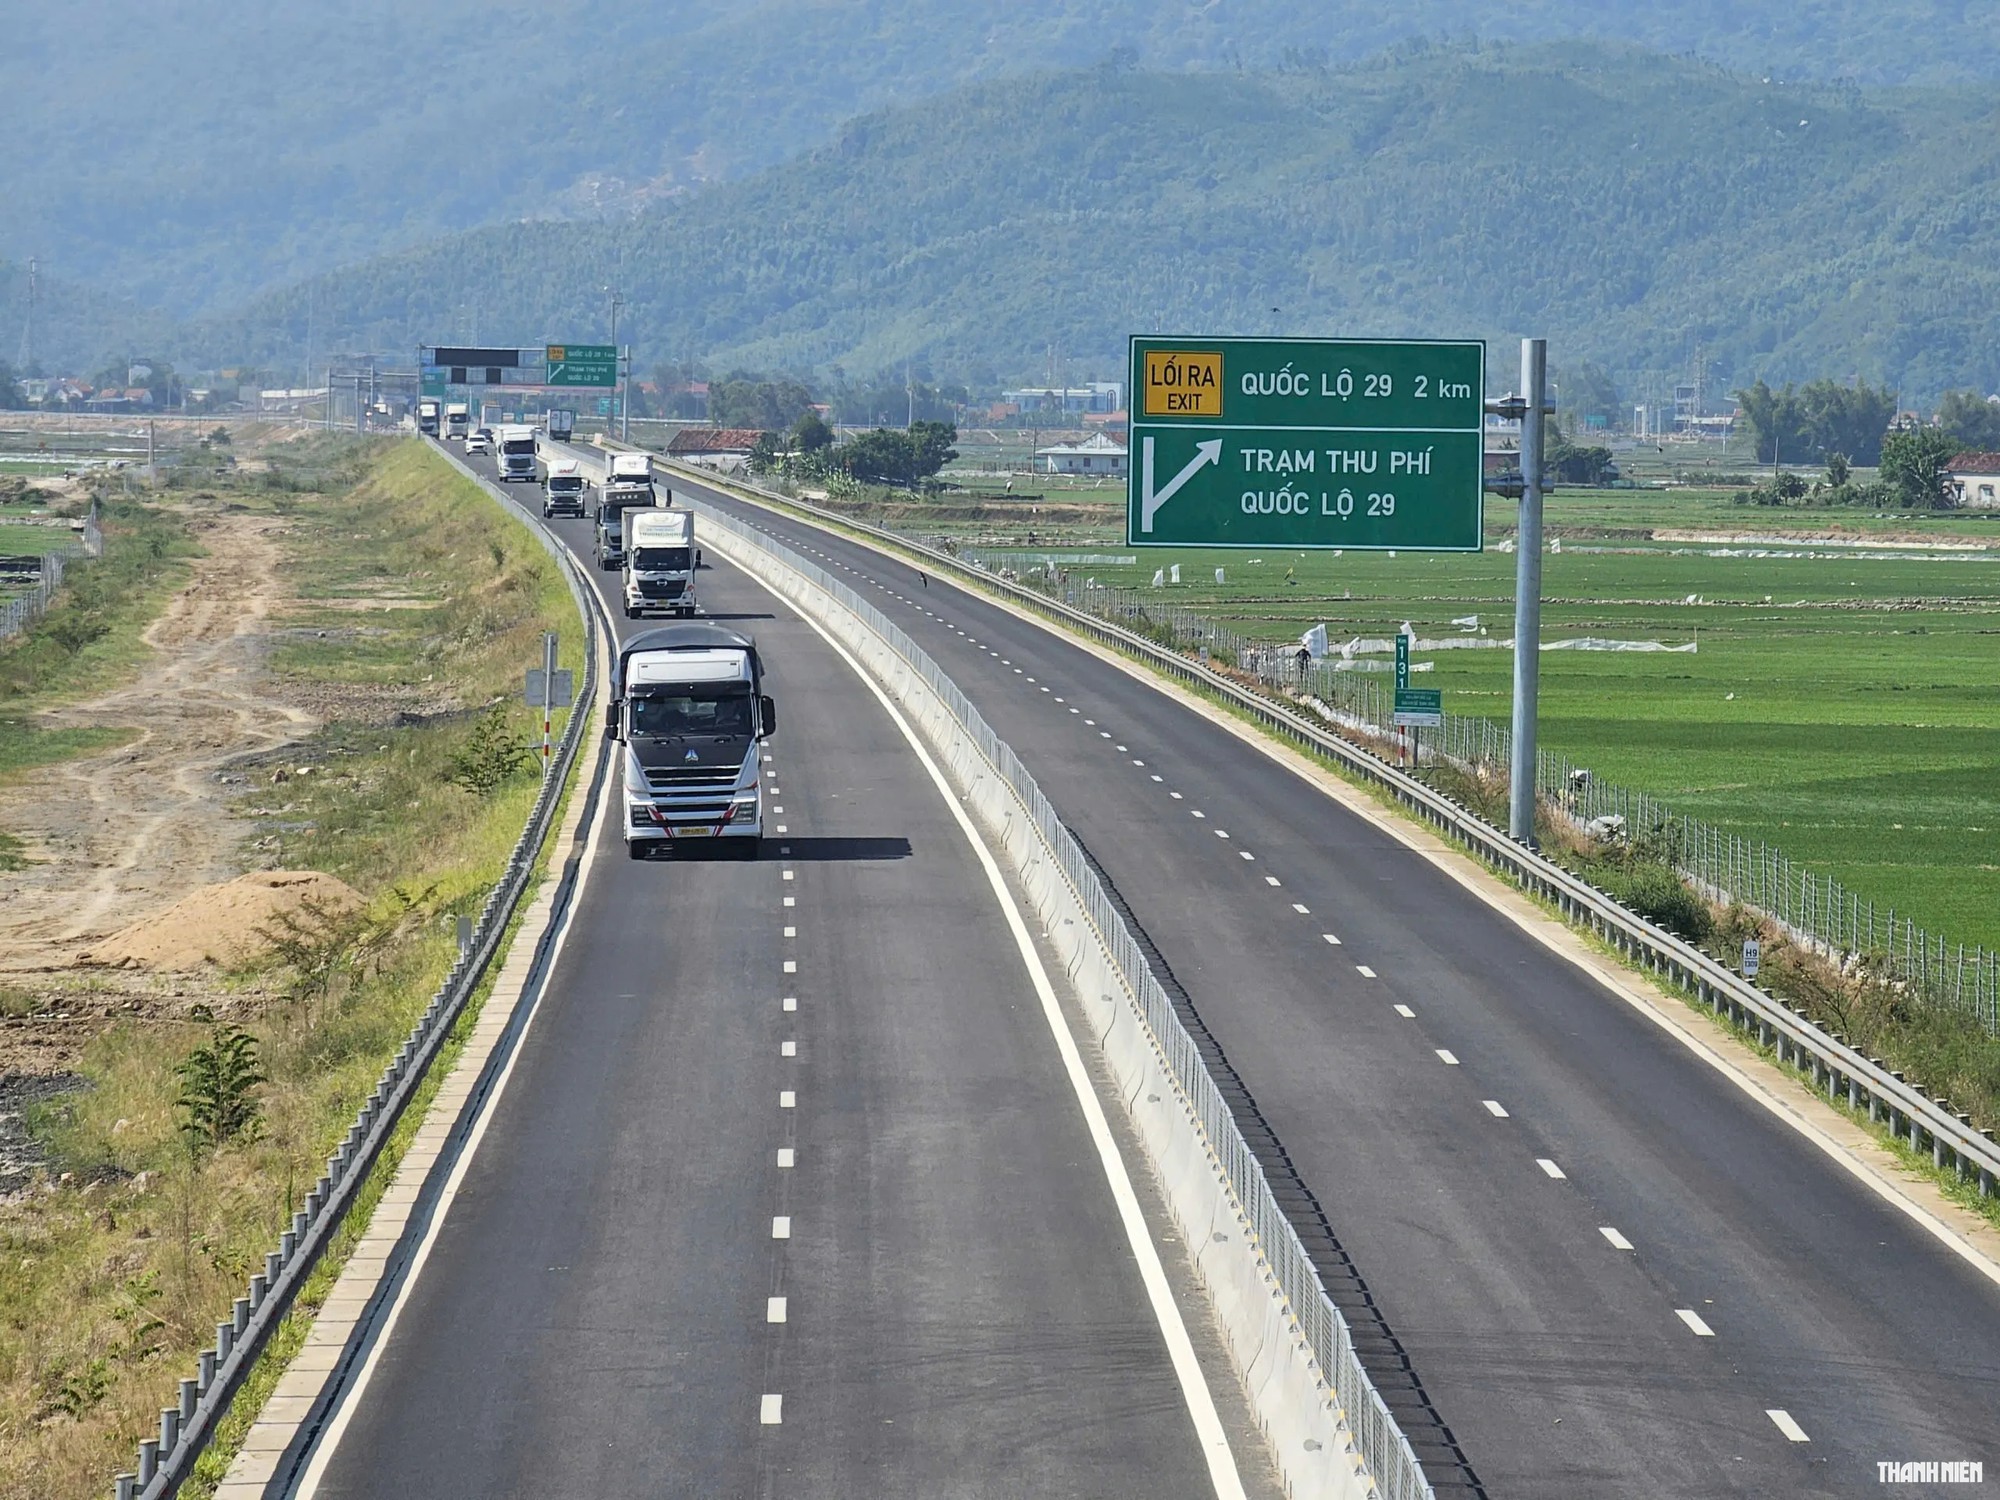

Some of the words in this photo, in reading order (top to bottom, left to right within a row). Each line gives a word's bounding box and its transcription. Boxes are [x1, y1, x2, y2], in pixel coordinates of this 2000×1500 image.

[1151, 355, 1182, 387] LỐI
[1188, 365, 1215, 387] RA
[1241, 362, 1310, 396] QUỐC
[1321, 368, 1353, 402] LỘ
[1364, 374, 1393, 397] 29
[1414, 375, 1428, 398] 2
[1439, 379, 1471, 399] km
[1167, 393, 1202, 410] EXIT
[1240, 449, 1315, 477] TRẠM
[1326, 450, 1377, 473] THU
[1390, 446, 1434, 475] PHÍ
[1241, 481, 1309, 515] QUỐC
[1321, 488, 1354, 521] LỘ
[1367, 493, 1395, 516] 29
[1746, 949, 1757, 957] H9
